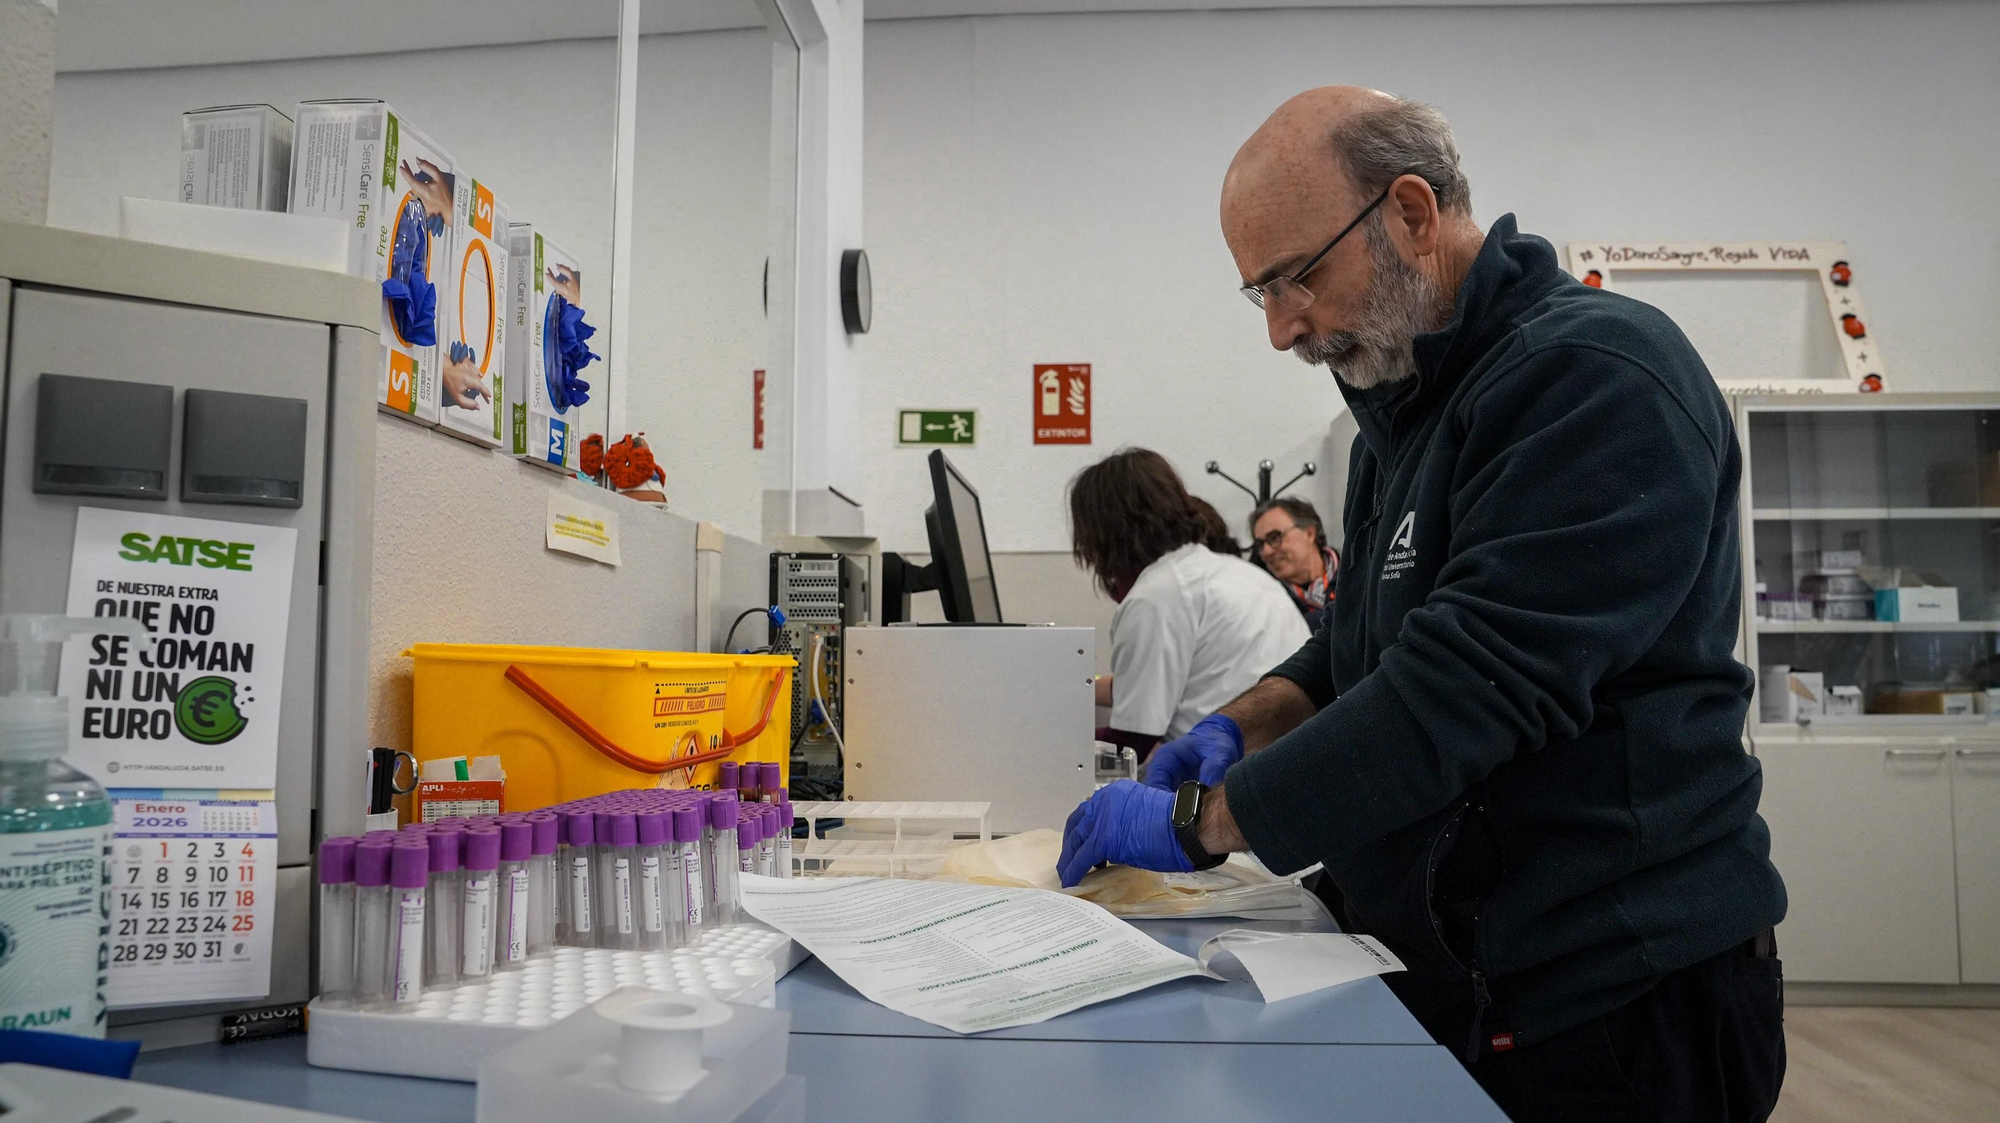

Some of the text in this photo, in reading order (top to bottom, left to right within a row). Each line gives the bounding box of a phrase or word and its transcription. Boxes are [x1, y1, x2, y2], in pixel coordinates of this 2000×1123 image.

[356, 203, 370, 228] Free
[478, 197, 492, 224] S
[376, 225, 388, 258] Free
[517, 306, 526, 326] Free
[392, 368, 410, 396] S
[550, 428, 564, 456] M
[1038, 428, 1086, 438] EXTINTOR
[118, 532, 255, 572] SATSE
[97, 580, 218, 601] DE NUESTRA EXTRA
[94, 598, 215, 636] QUE NO
[89, 634, 254, 673] SE COMAN
[86, 668, 180, 702] NI UN
[687, 700, 706, 710] PELIGRO
[82, 706, 172, 740] EURO
[422, 784, 444, 792] APLI
[135, 804, 186, 814] Enero
[132, 817, 188, 828] 2026
[160, 842, 254, 858] 1 2 3 4
[128, 866, 254, 884] 7 8 9 10 11
[120, 890, 254, 909] 14 15 16 17 18
[946, 899, 1010, 920] CONSENTIMIENTO
[119, 915, 254, 936] 21 22 23 24 25
[860, 934, 896, 944] DECLARO
[1062, 938, 1098, 956] CONSULTE
[113, 941, 222, 962] 28 29 30 31
[918, 982, 945, 992] CASOS
[946, 973, 991, 986] SIGUIENTES
[236, 1008, 299, 1024] KODAK
